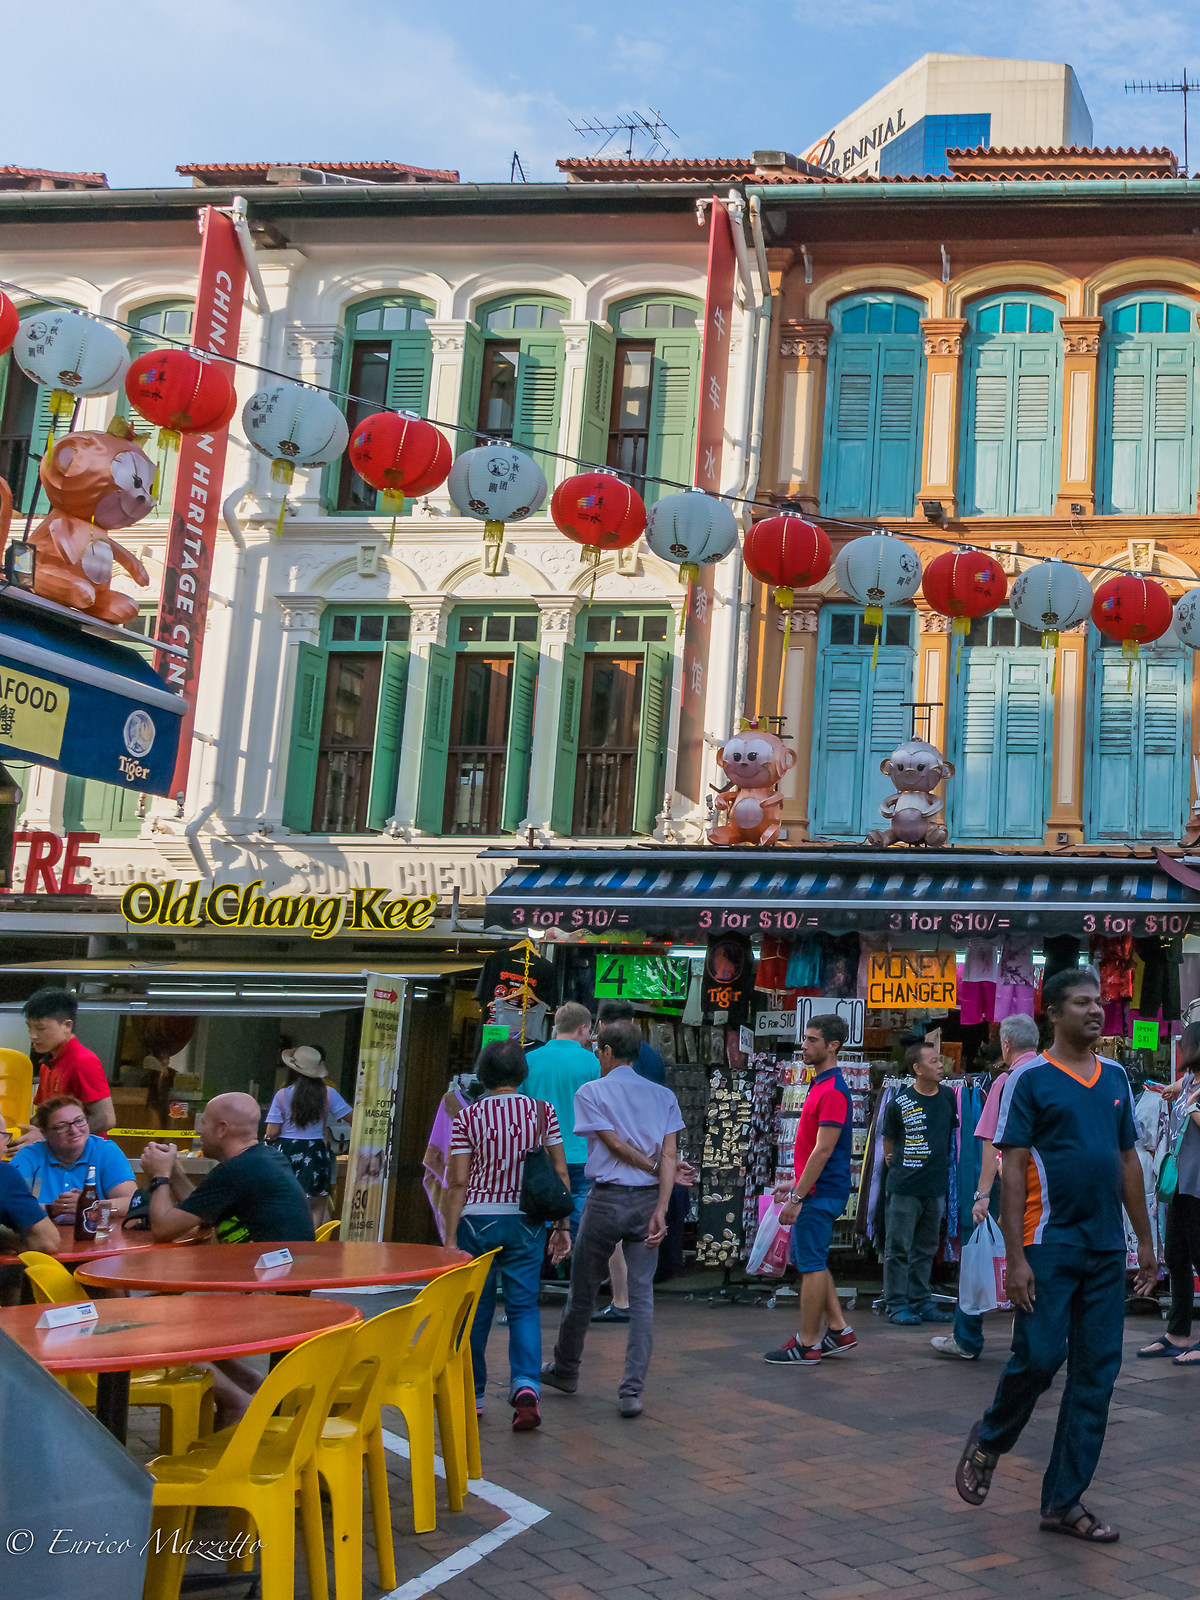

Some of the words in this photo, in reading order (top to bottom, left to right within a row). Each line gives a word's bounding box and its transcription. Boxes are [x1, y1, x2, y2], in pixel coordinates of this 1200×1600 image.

[176, 461, 212, 614] HERITAGE
[118, 755, 150, 782] Tiger
[121, 878, 202, 927] Old
[206, 880, 347, 940] Chang
[349, 887, 436, 931] Kee
[511, 908, 525, 925] 3
[532, 908, 564, 925] for
[699, 910, 713, 928] 3
[721, 910, 751, 927] for
[889, 913, 903, 930] 3
[910, 912, 942, 930] for
[1083, 914, 1097, 933] 3
[1104, 914, 1136, 933] for
[599, 958, 628, 995] 4
[871, 953, 949, 980] MONEY
[869, 982, 956, 1004] CHANGER
[758, 1015, 767, 1029] 6
[768, 1019, 779, 1028] FOR
[780, 1013, 796, 1028] $10
